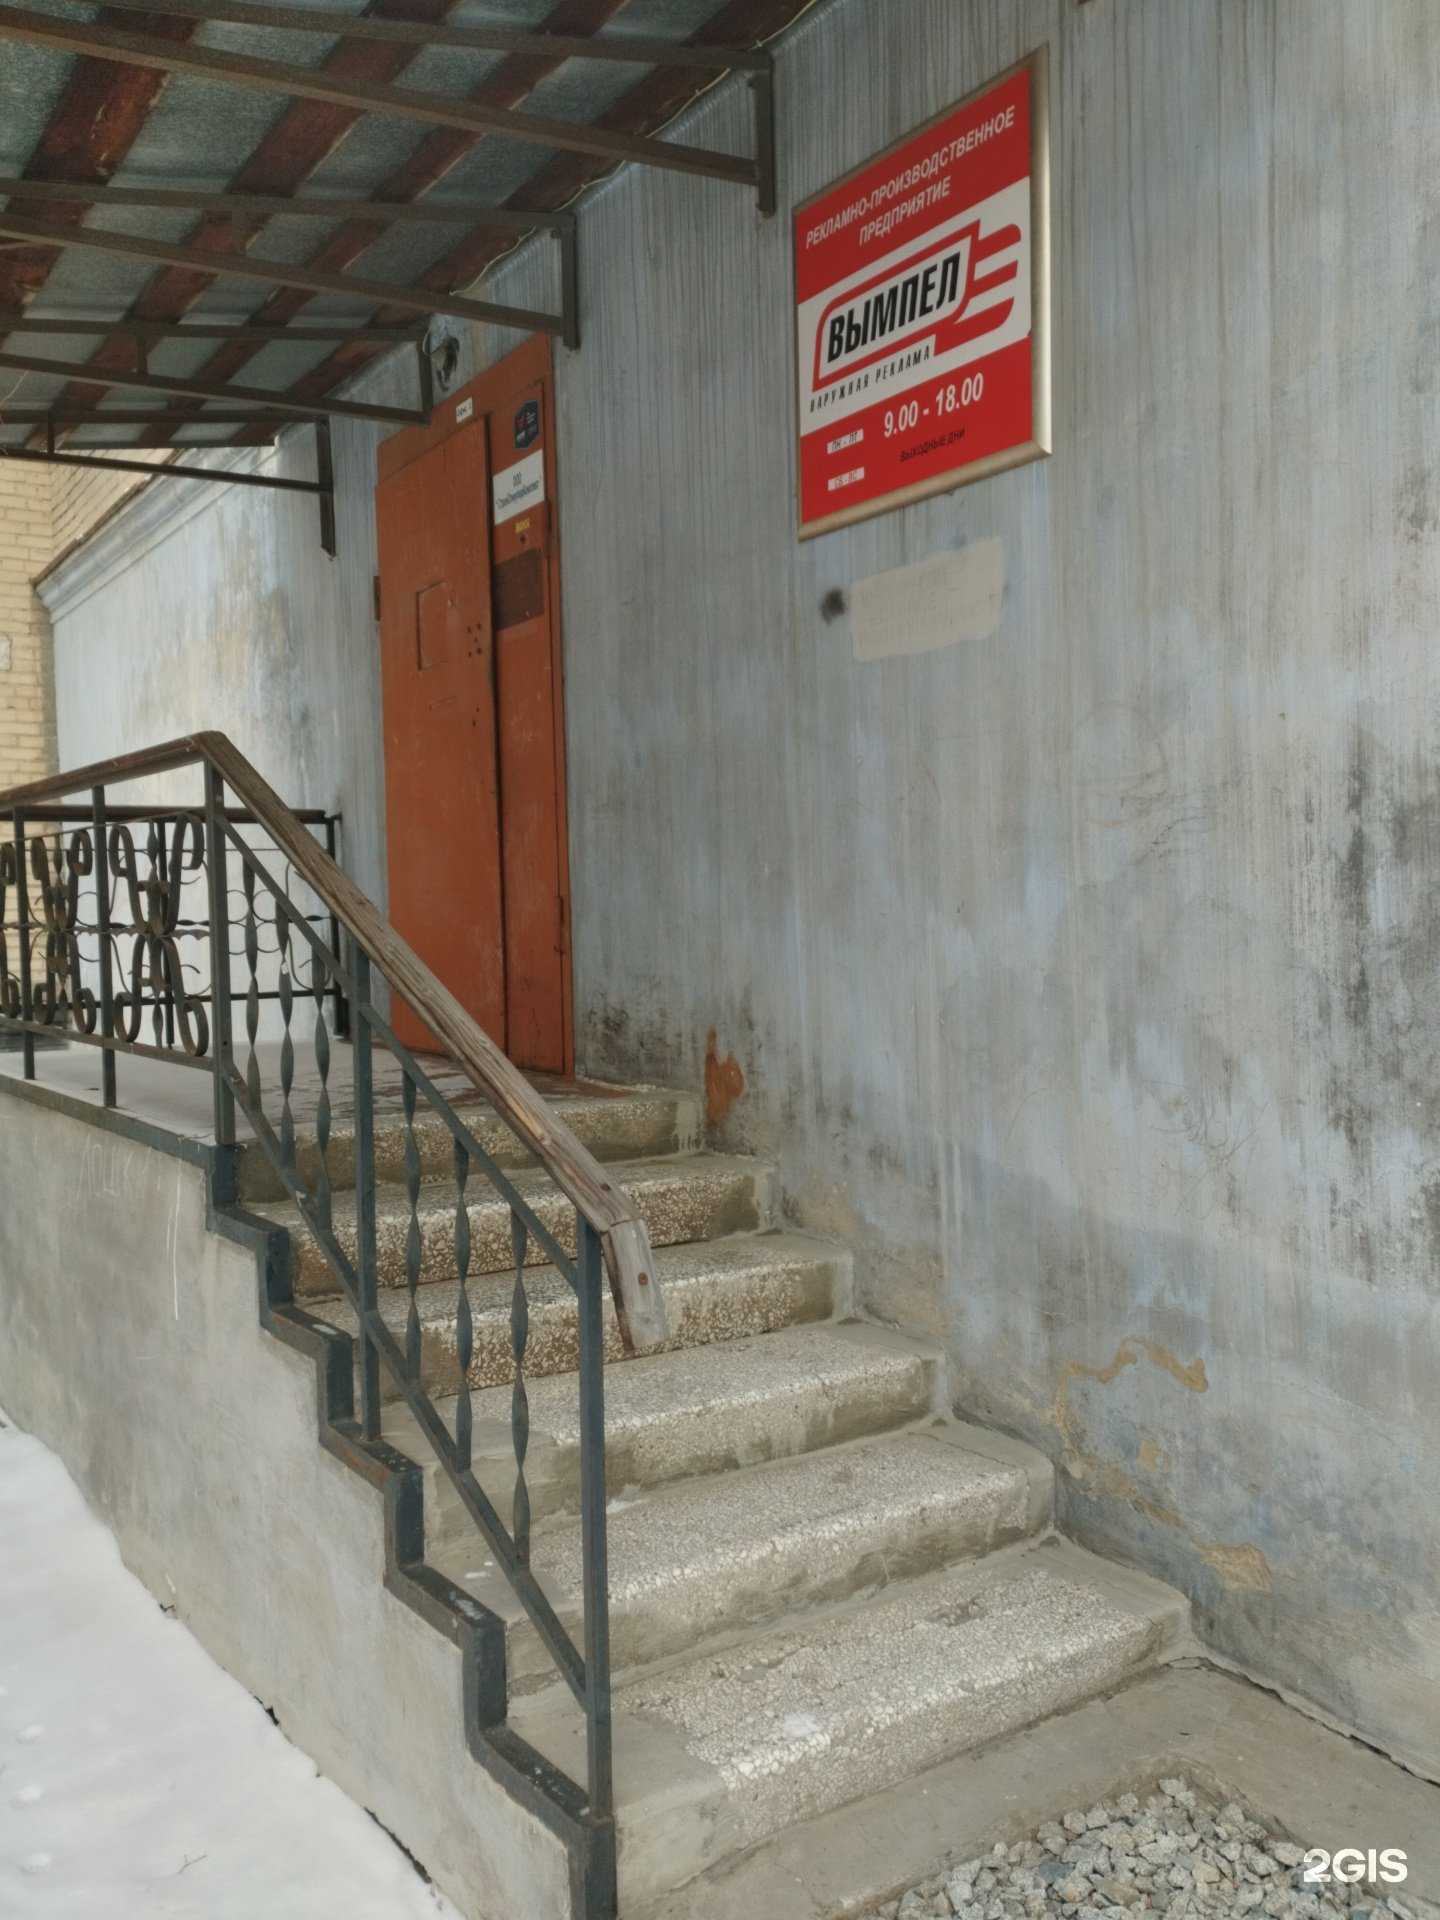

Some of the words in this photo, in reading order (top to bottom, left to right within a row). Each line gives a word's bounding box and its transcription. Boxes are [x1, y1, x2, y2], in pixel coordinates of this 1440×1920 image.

[806, 105, 1015, 249] РЕКЛАМНО-ПРОИЗВОДСТВЕННОЕ
[859, 176, 951, 247] ПРЕДПРИЯТИЕ
[827, 251, 961, 363] ВЫМПЕЛ
[810, 373, 869, 413] НАРУЖНАЯ
[875, 345, 930, 384] РЕКЛАМА
[884, 400, 919, 438] 9.00
[935, 372, 984, 417] 18.00
